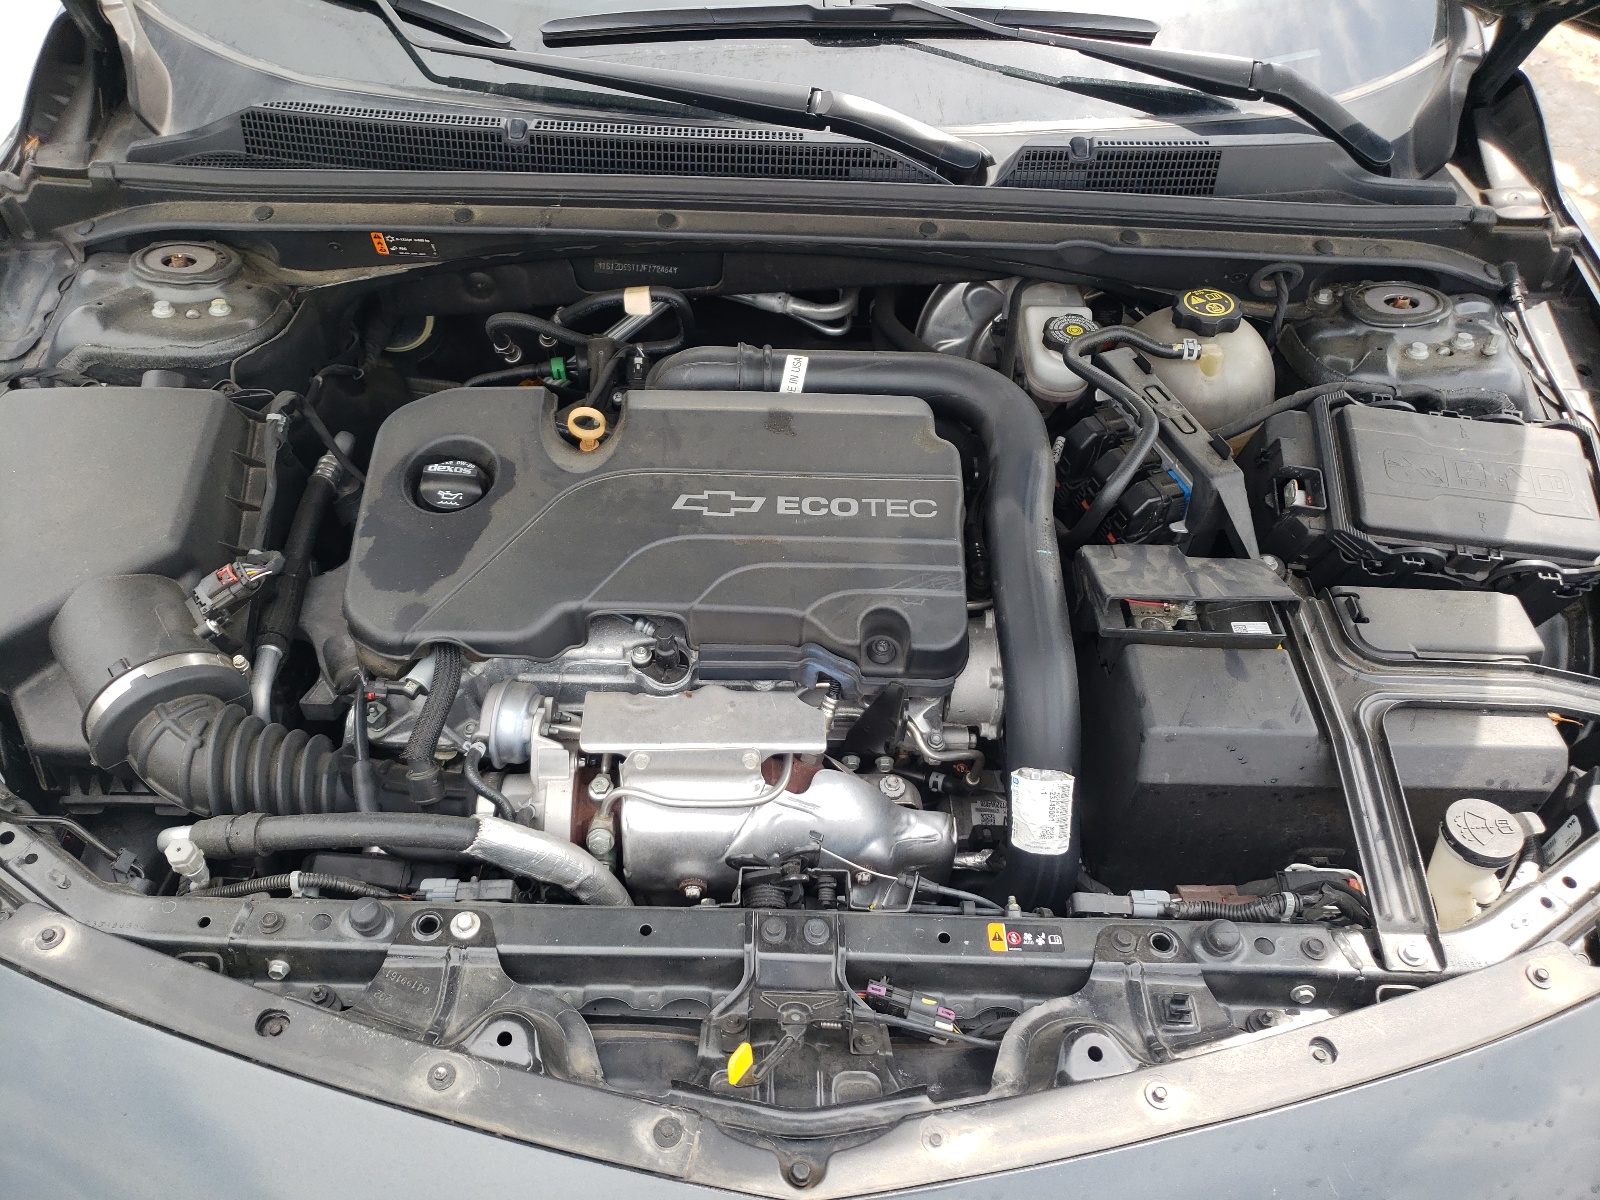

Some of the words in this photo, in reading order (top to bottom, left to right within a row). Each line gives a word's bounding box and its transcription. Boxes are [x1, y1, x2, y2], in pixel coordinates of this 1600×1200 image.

[790, 357, 803, 373] USA
[788, 374, 799, 385] IN
[427, 463, 474, 475] dexos
[776, 495, 938, 518] ECOTEC
